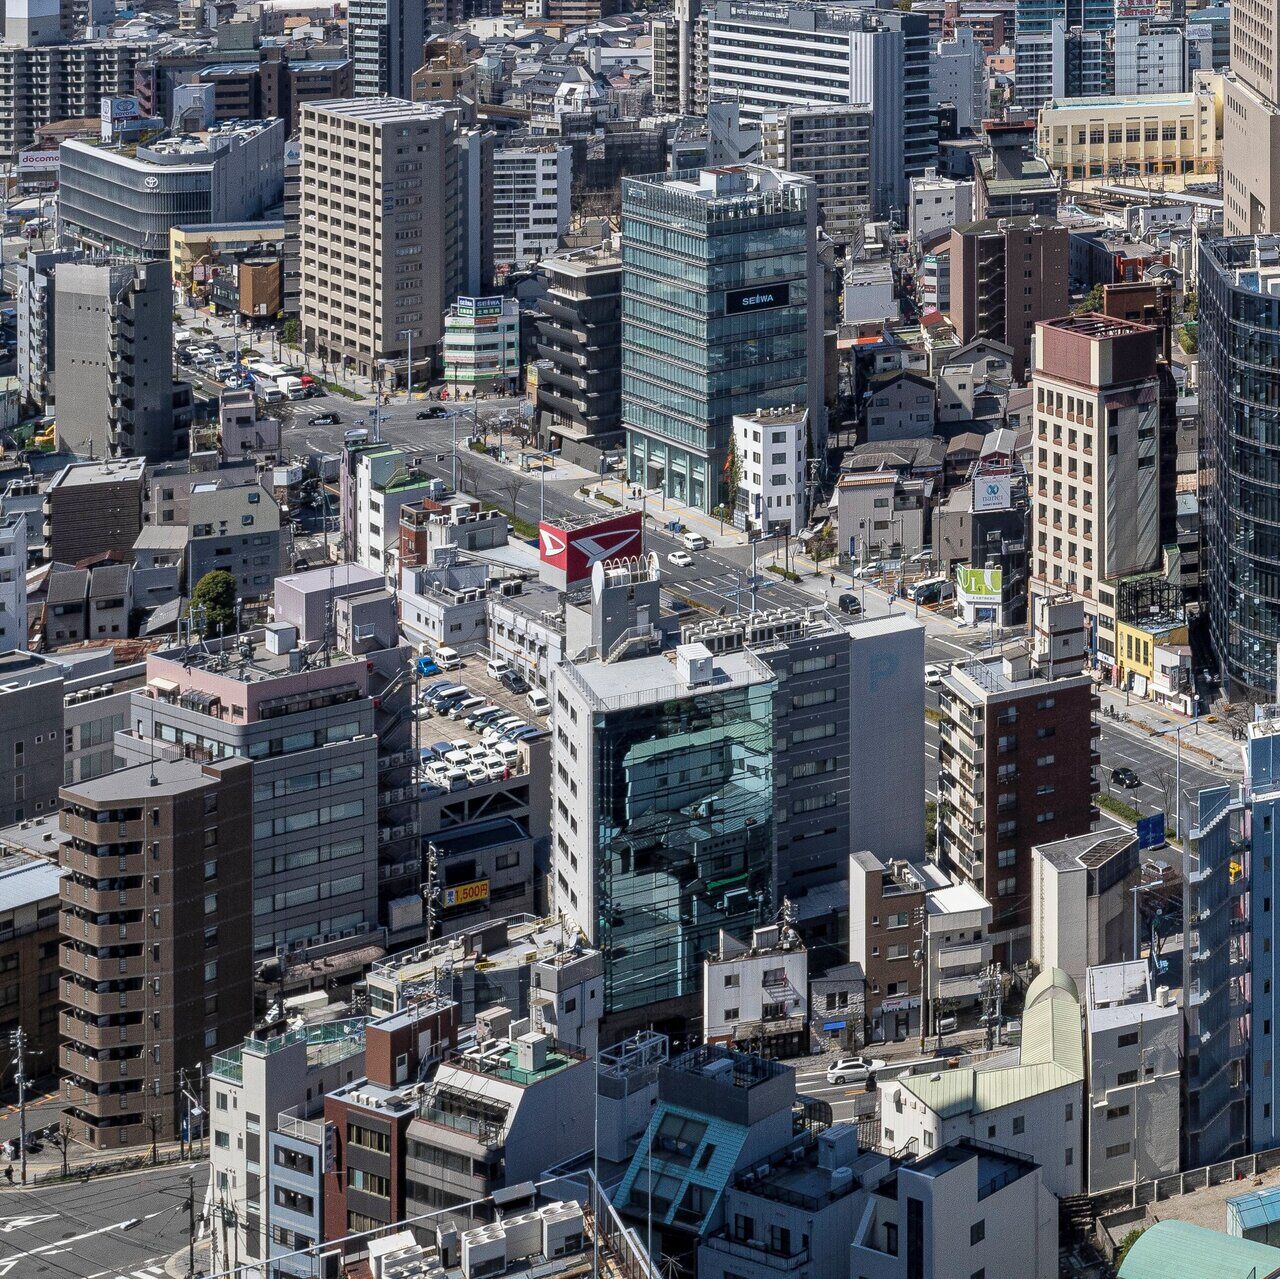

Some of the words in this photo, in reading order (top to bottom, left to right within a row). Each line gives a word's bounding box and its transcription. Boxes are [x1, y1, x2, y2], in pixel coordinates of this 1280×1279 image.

[23, 153, 60, 164] docomo
[742, 293, 774, 307] SEIWA
[456, 883, 489, 904] 1,500円
